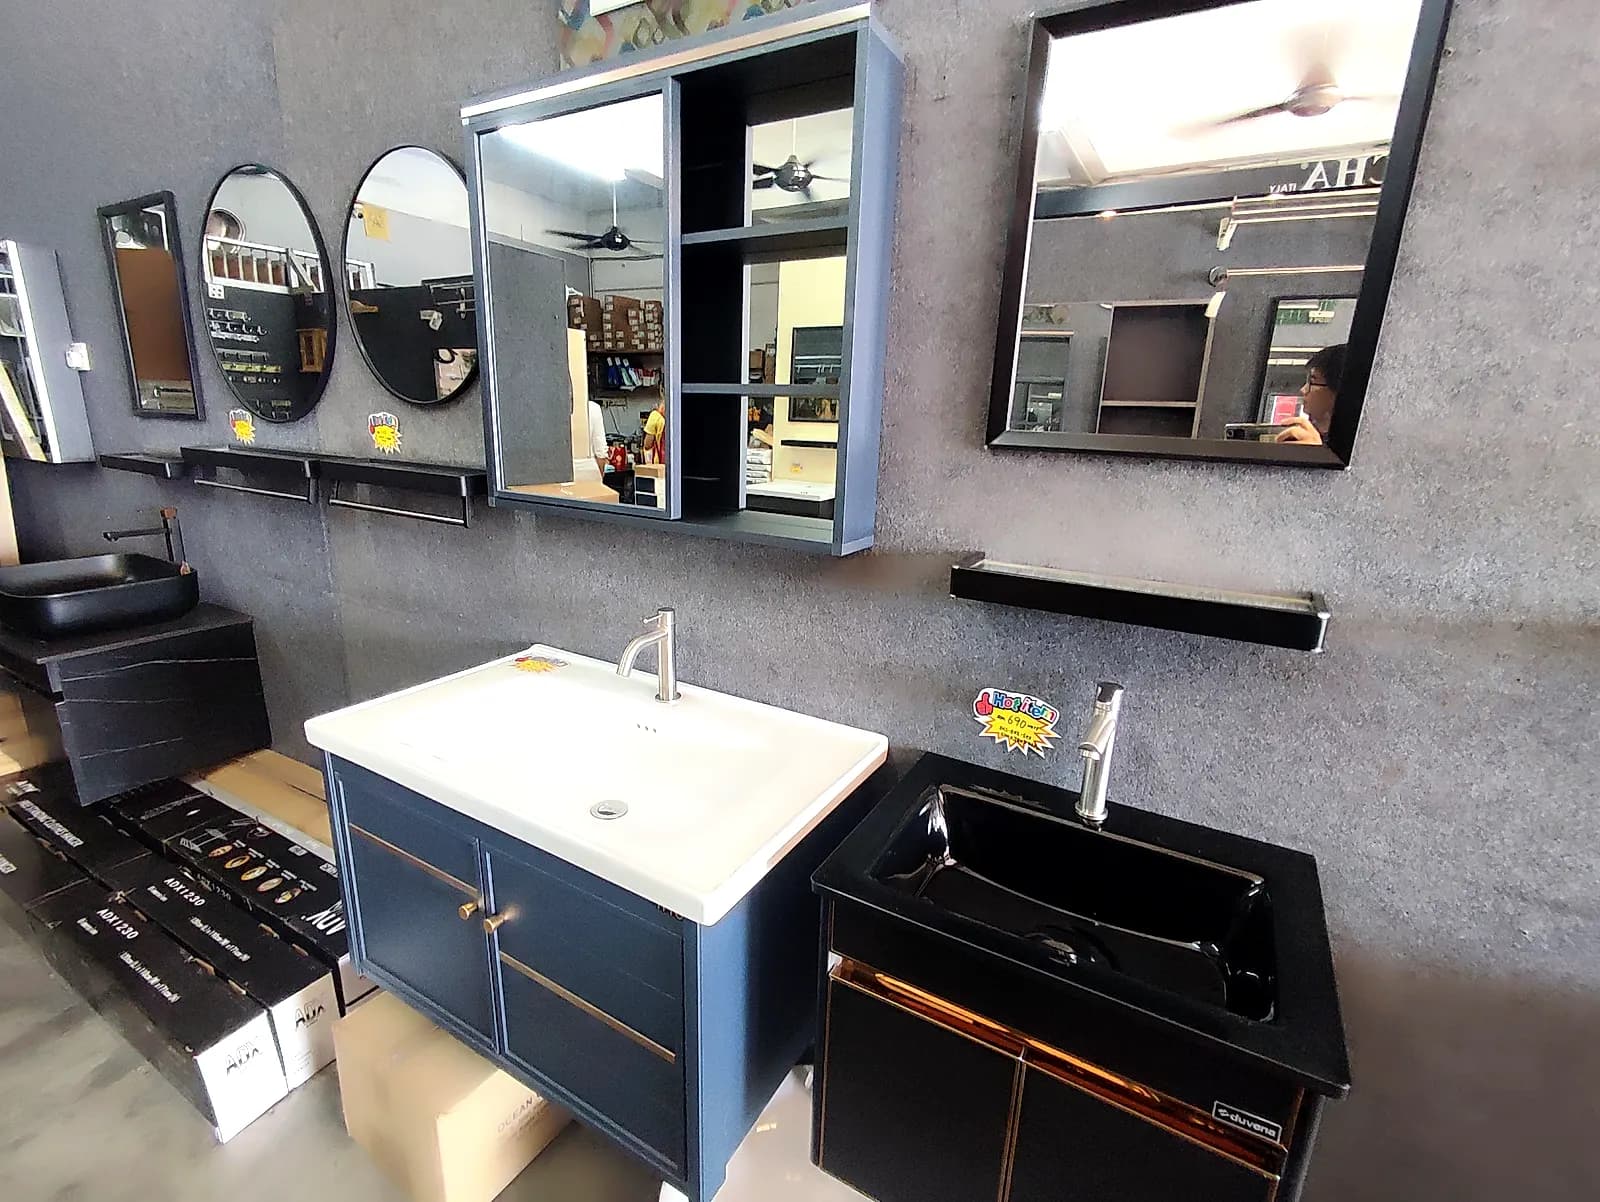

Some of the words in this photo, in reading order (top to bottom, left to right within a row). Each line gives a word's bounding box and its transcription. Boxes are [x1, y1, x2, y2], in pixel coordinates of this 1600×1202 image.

[993, 691, 1021, 711] Hot
[1020, 696, 1057, 723] item
[1007, 714, 1027, 729] 690
[163, 877, 206, 907] ADX1230
[96, 907, 140, 940] ADX1230
[1229, 1113, 1277, 1138] duvena
